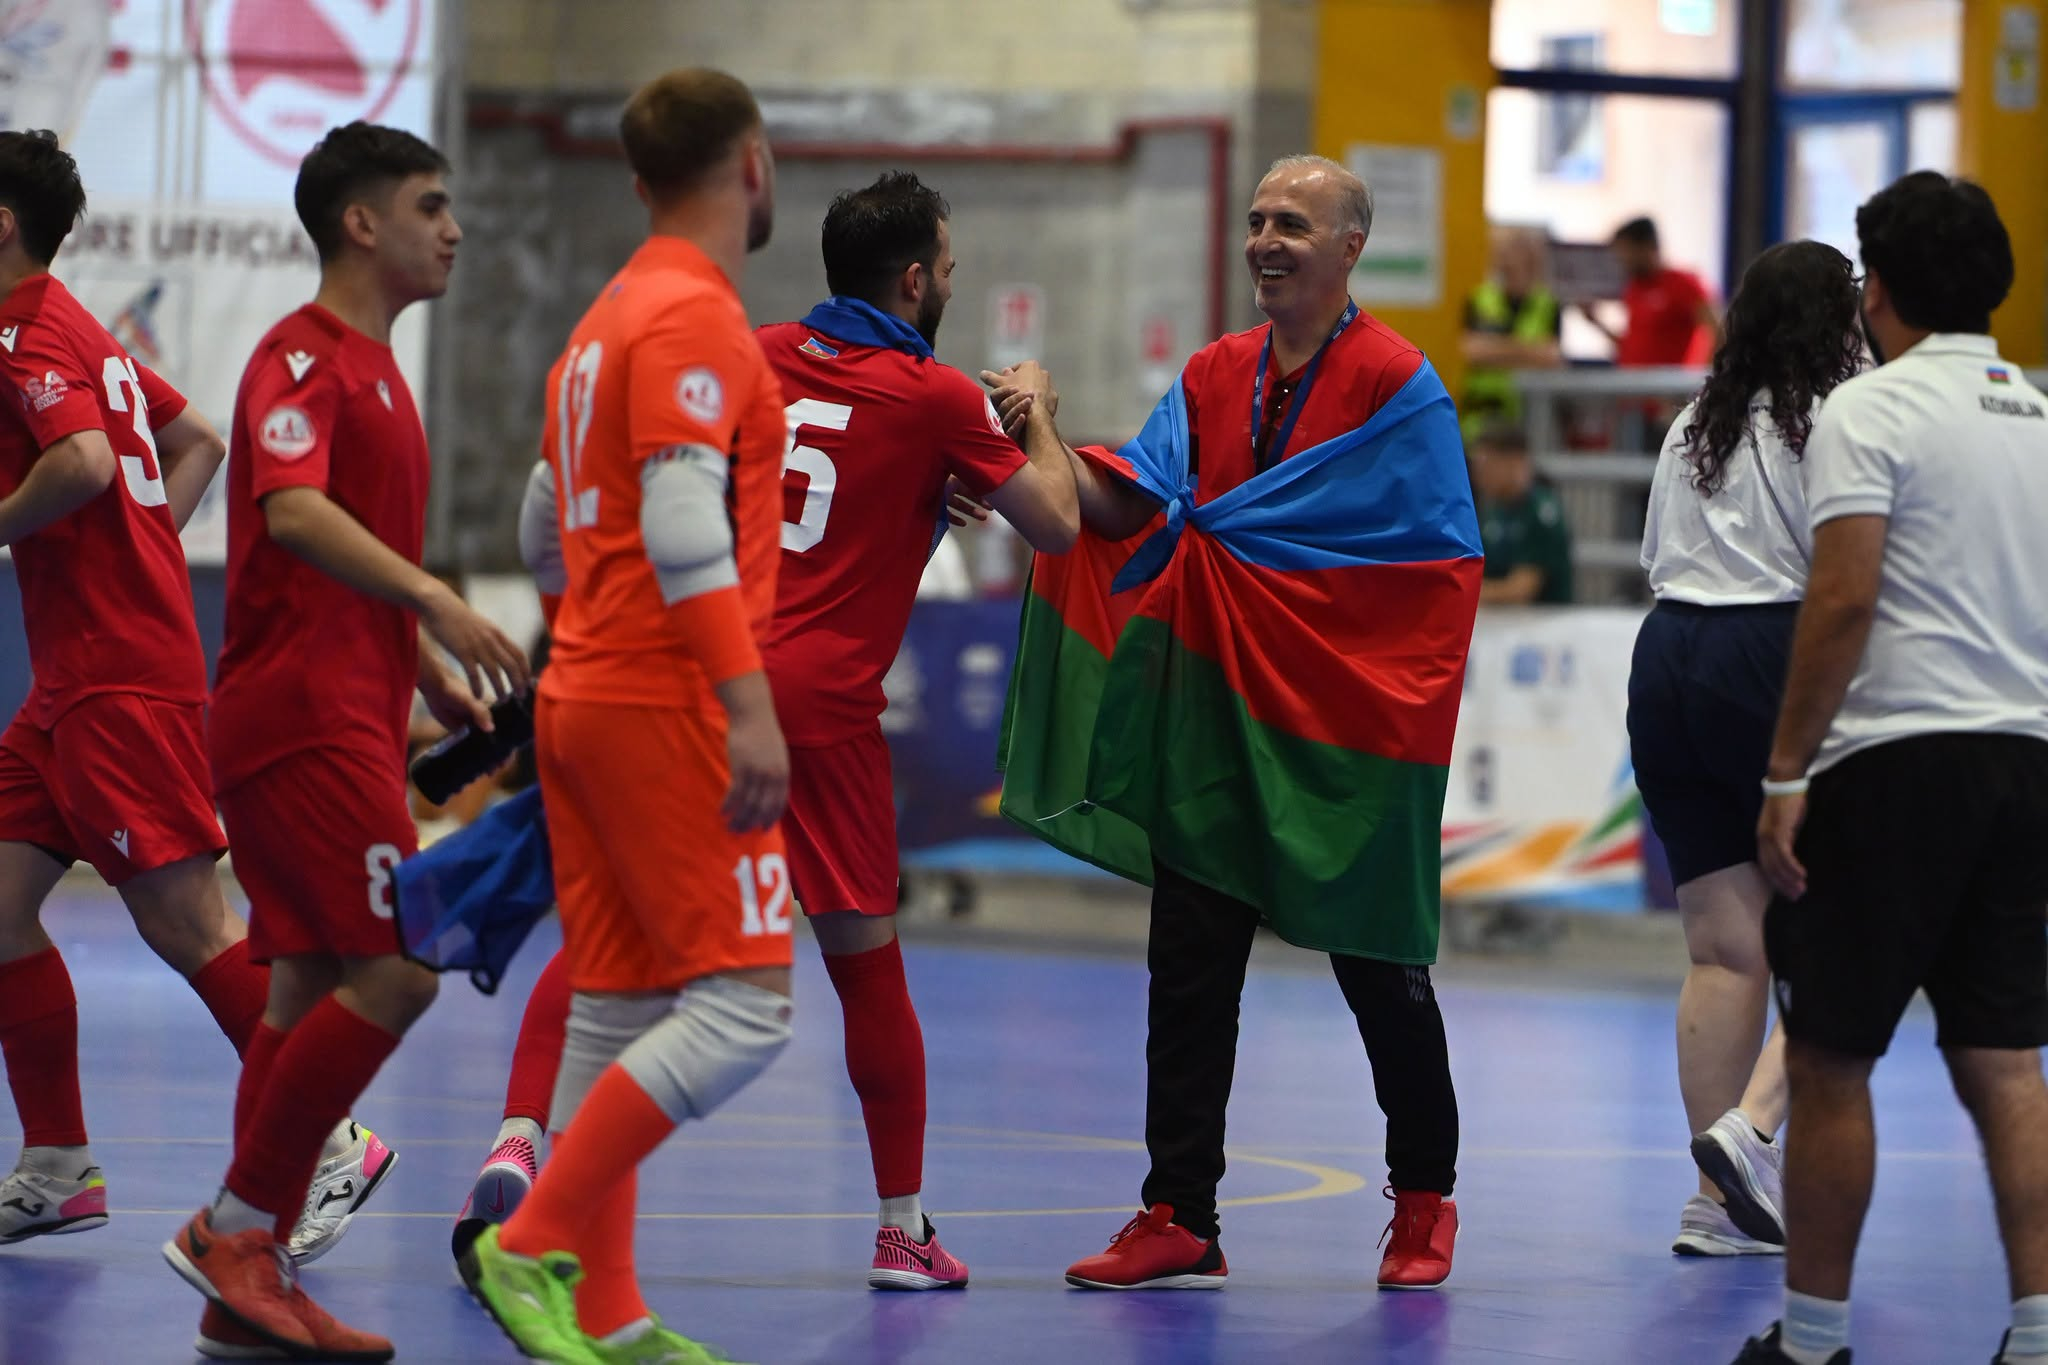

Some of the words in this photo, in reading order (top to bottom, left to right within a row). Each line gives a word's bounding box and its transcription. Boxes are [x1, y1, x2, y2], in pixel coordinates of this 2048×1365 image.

[102, 356, 168, 507] 3
[365, 843, 402, 918] 8
[733, 853, 793, 935] 12
